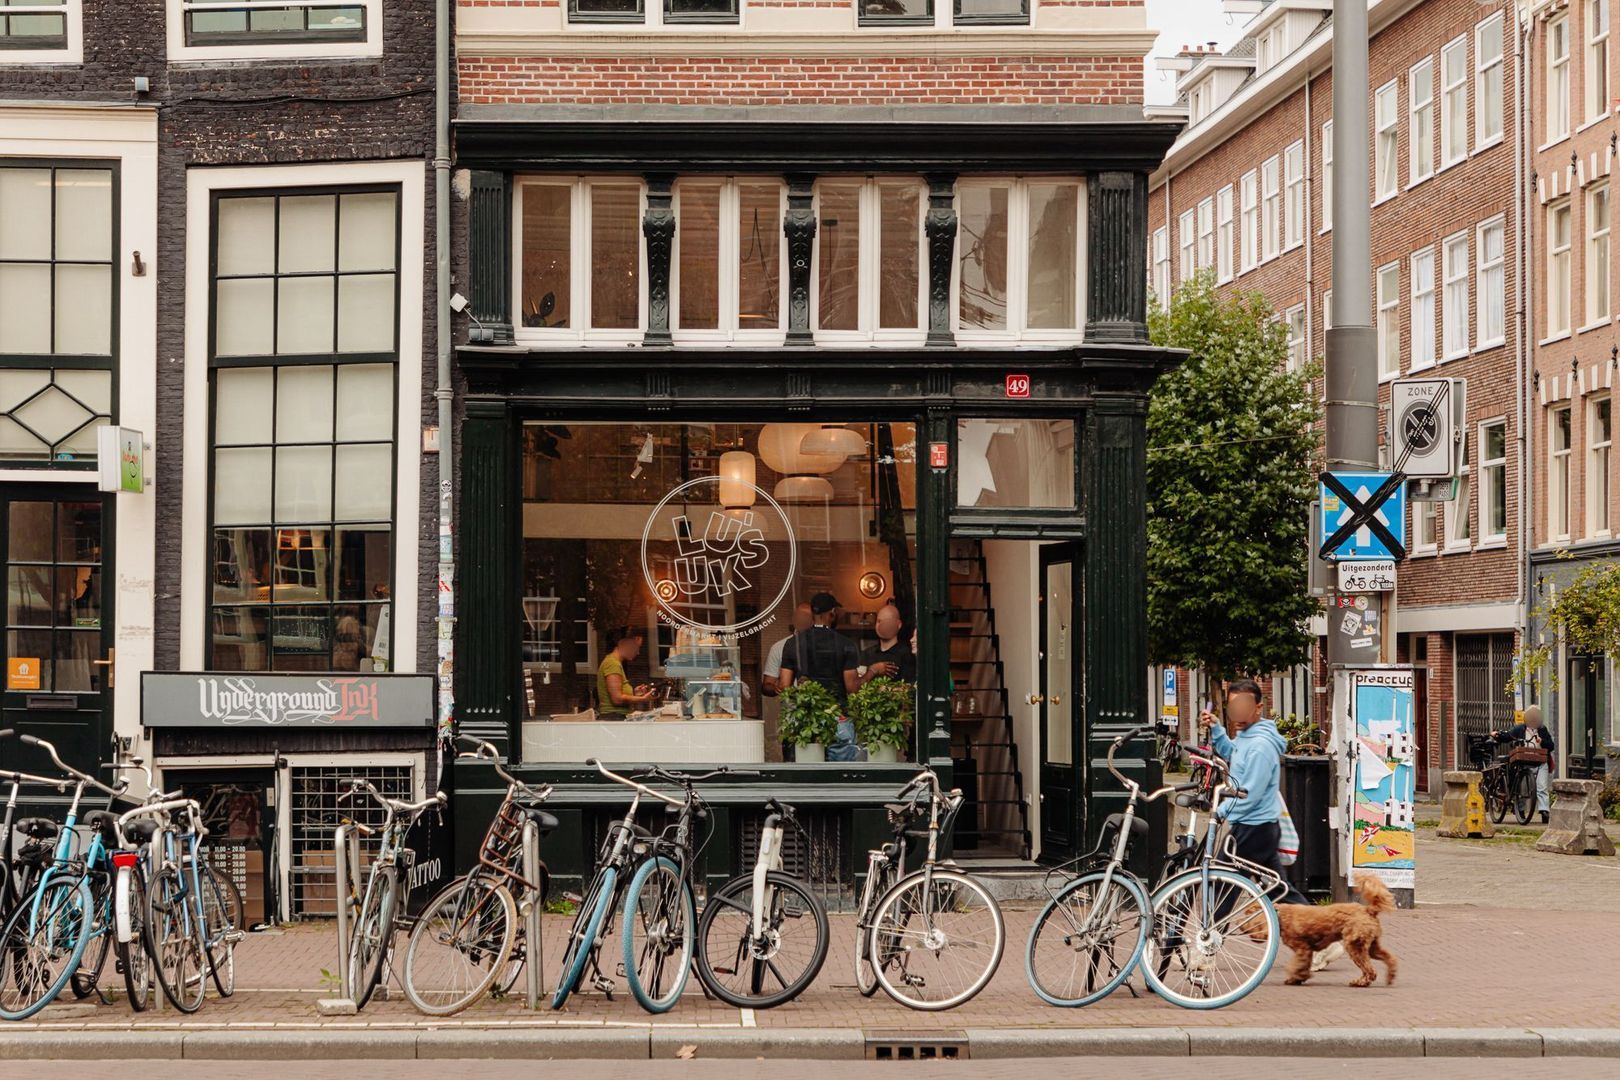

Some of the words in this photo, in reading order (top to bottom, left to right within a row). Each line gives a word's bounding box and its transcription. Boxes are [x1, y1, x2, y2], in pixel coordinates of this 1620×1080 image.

[1009, 379, 1027, 393] 49
[1407, 387, 1434, 397] ZONE
[674, 552, 753, 597] UK
[1342, 564, 1393, 574] Uitgezonderd
[722, 614, 777, 641] VIJZELGRACHT
[1167, 672, 1173, 686] P
